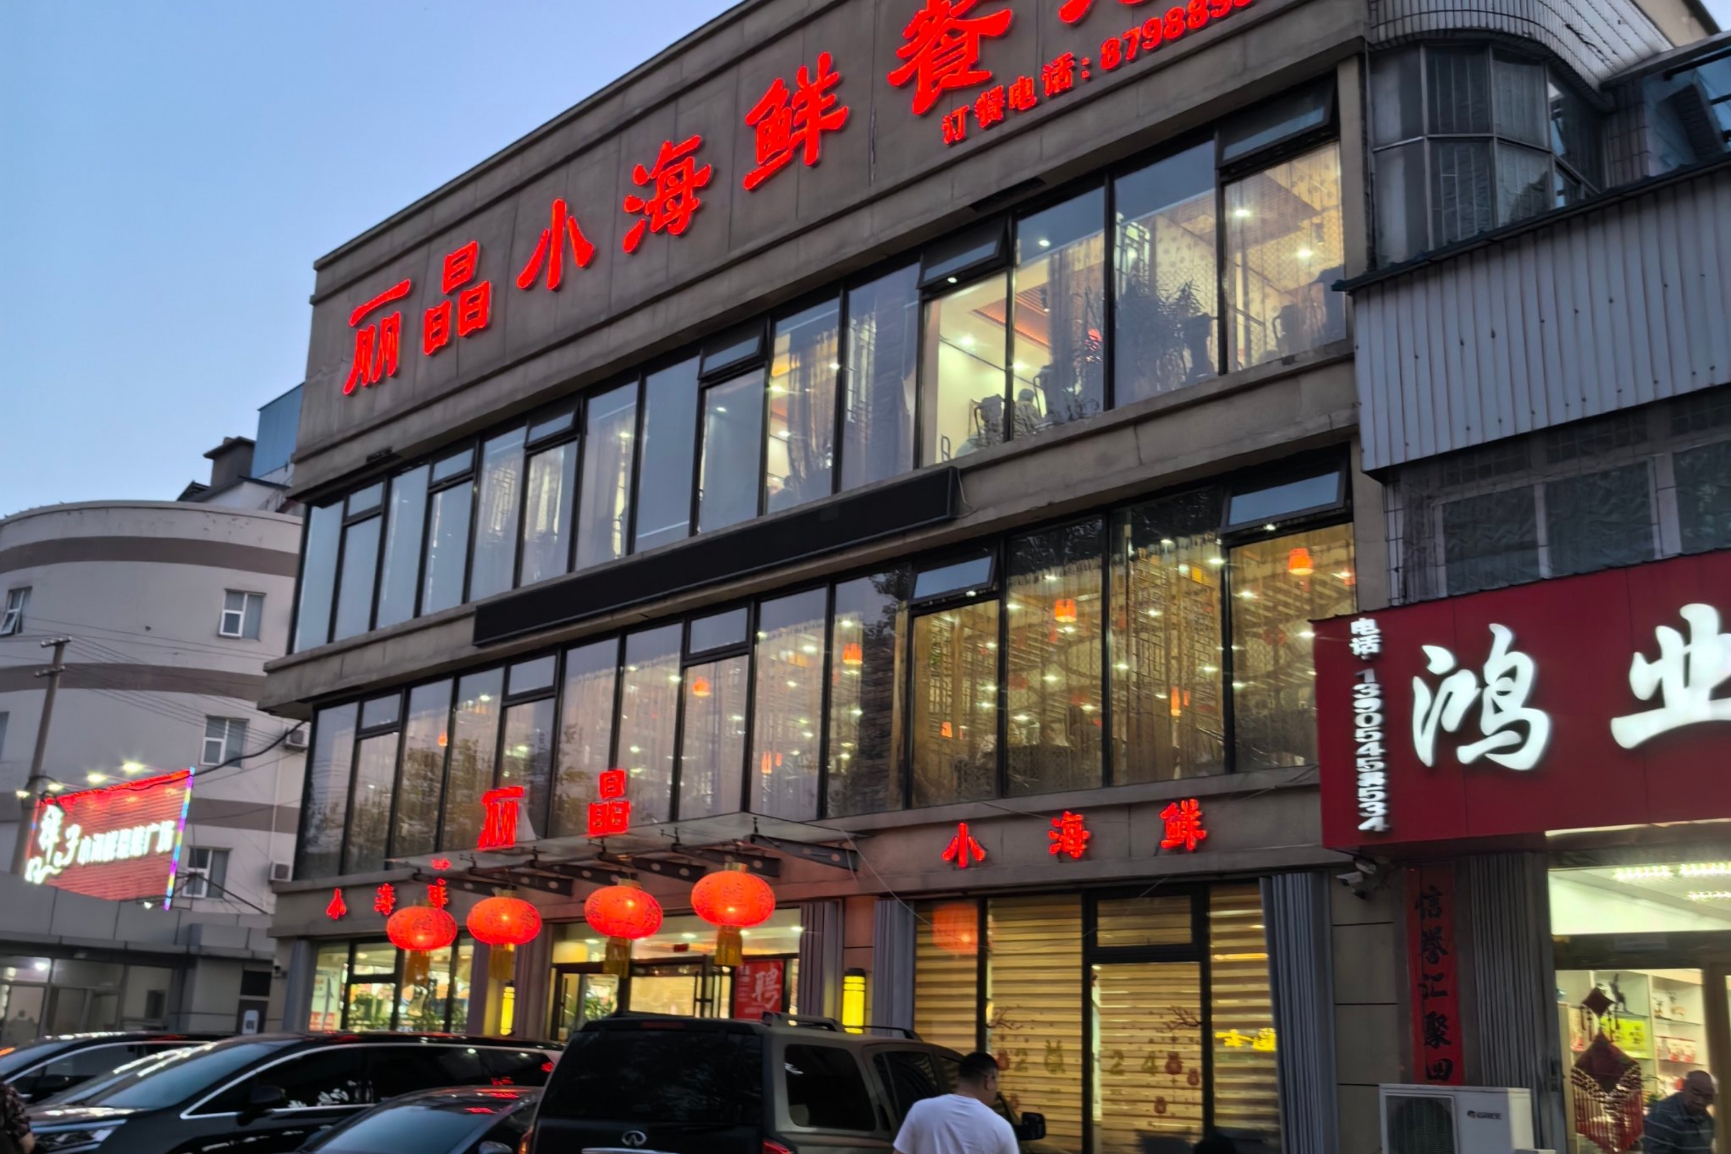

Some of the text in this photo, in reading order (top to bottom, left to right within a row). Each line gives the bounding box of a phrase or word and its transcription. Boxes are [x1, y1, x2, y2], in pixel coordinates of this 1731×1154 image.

[343, 0, 1142, 396] 丽晶小海鲜餐
[1411, 602, 1731, 771] 鸿业
[477, 768, 631, 850] 丽晶
[941, 798, 1208, 869] 小海鲜
